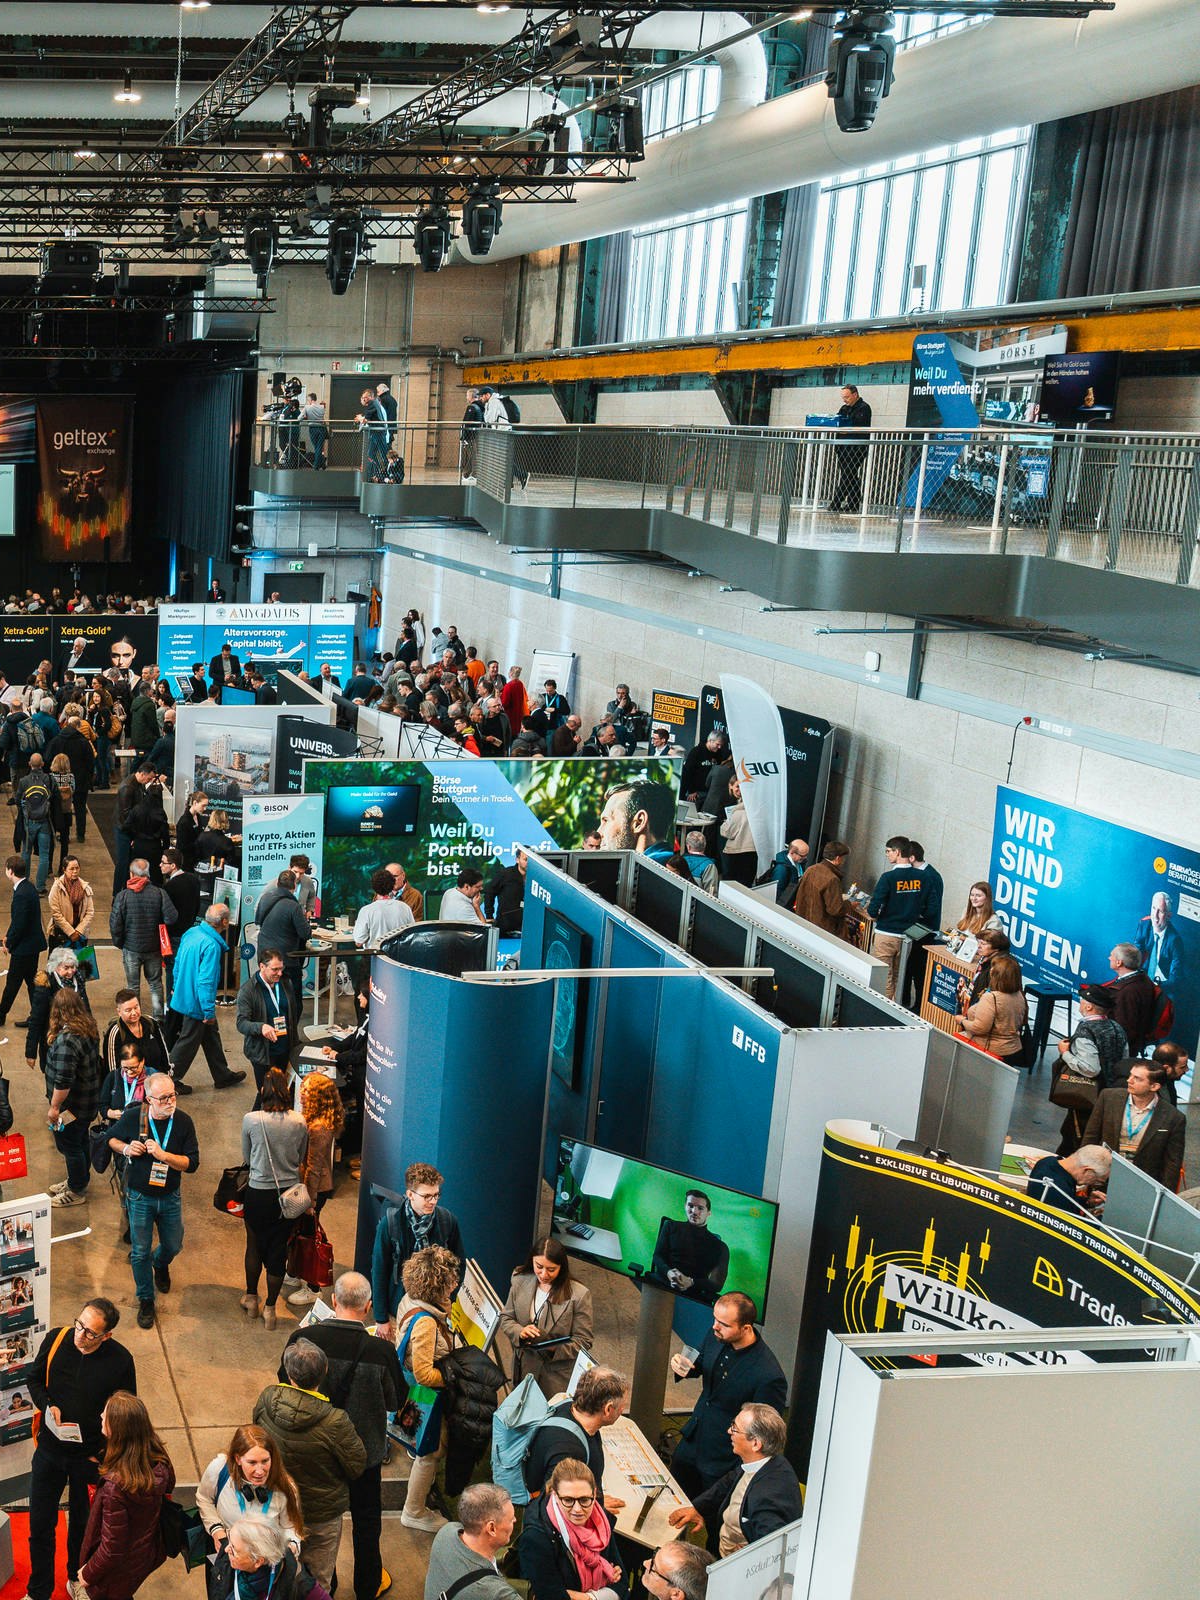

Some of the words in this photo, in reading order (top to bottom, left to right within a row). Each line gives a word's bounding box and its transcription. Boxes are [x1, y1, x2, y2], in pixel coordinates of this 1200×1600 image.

[1000, 344, 1036, 360] BÖRSE
[915, 368, 932, 380] Weil
[935, 367, 947, 379] Du
[913, 383, 935, 395] mehr
[936, 381, 981, 395] verdienst.
[53, 429, 108, 450] gettex
[87, 448, 116, 456] exchange
[224, 629, 288, 638] Altersvorsorge.
[227, 639, 257, 648] Kapital
[257, 639, 284, 648] bleibt.
[655, 694, 695, 708] GELDANLAGE
[706, 694, 716, 705] DJE
[654, 703, 684, 715] BRAUCHT
[653, 712, 684, 724] EXPERTEN
[714, 720, 724, 730] Wir
[807, 728, 821, 737] dje.de
[433, 775, 461, 785] Börse
[432, 785, 478, 796] Stuttgart
[432, 795, 450, 803] Dein
[452, 795, 480, 803] Partner
[264, 804, 289, 812] BISON
[430, 823, 467, 838] Weil
[471, 823, 495, 838] Du
[1004, 804, 1056, 851] WIR
[248, 832, 282, 843] Krypto,
[284, 831, 316, 840] Aktien
[248, 842, 266, 852] und
[289, 841, 316, 849] sicher
[248, 853, 287, 862] handeln.
[427, 861, 463, 876] bist.
[999, 841, 1063, 889] SIND
[897, 880, 921, 891] FAIR
[538, 885, 551, 905] FFB
[995, 874, 1038, 918] DIE
[997, 909, 1088, 979] GUTEN.
[936, 970, 944, 979] Ein
[945, 973, 956, 984] Jahr
[745, 1035, 766, 1064] FFB
[875, 1156, 928, 1178] EXKLUSIVE
[930, 1172, 1000, 1203] CLUBVORTEILE
[1020, 1204, 1083, 1241] GEMEINSAMES
[1084, 1233, 1118, 1261] TRADEN
[1132, 1265, 1190, 1316] PROFESSIONELLE
